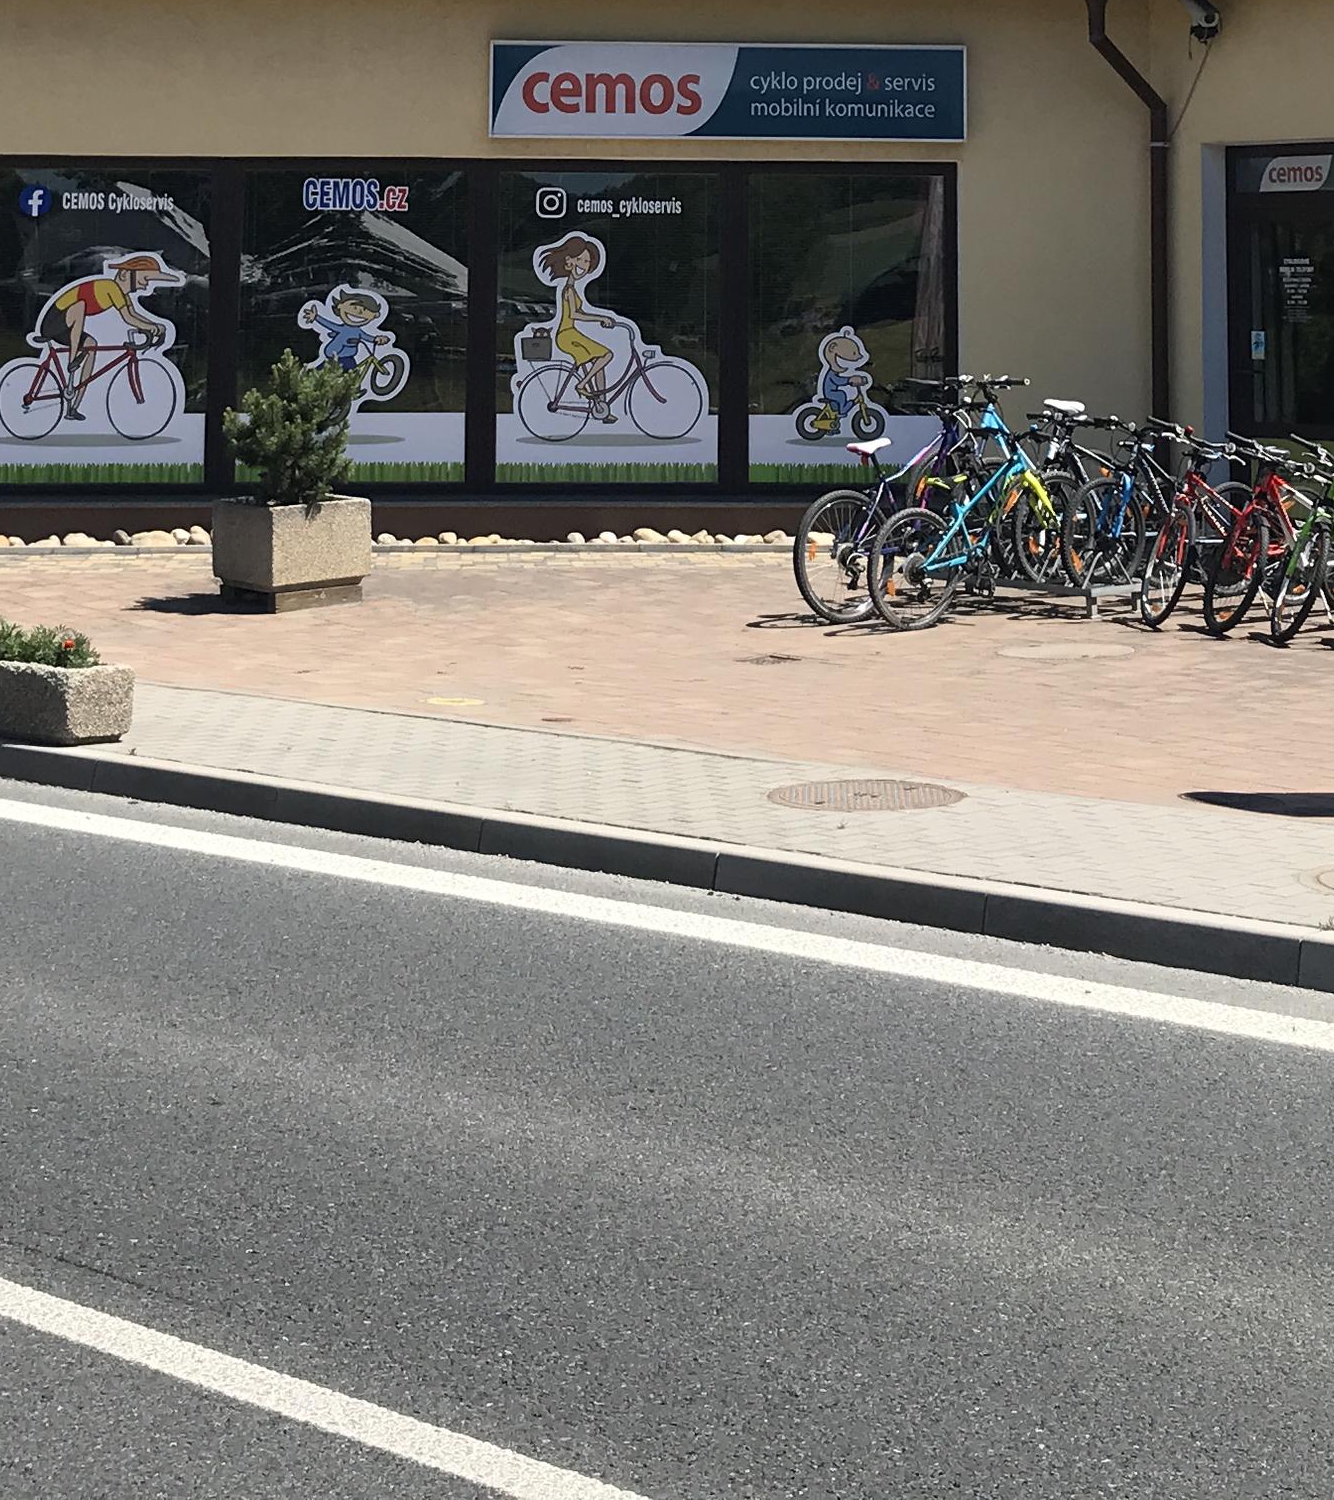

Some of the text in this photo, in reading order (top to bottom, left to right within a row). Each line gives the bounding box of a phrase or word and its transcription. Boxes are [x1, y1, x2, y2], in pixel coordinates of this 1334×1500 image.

[522, 71, 703, 116] cemos
[750, 71, 936, 95] cyklo prodej & servis
[750, 98, 936, 118] mobilní komunikace
[1268, 166, 1323, 183] cemos
[62, 192, 105, 210] CEMOS
[108, 192, 174, 214] Cykloservis
[577, 197, 682, 218] cemos_cykloservis
